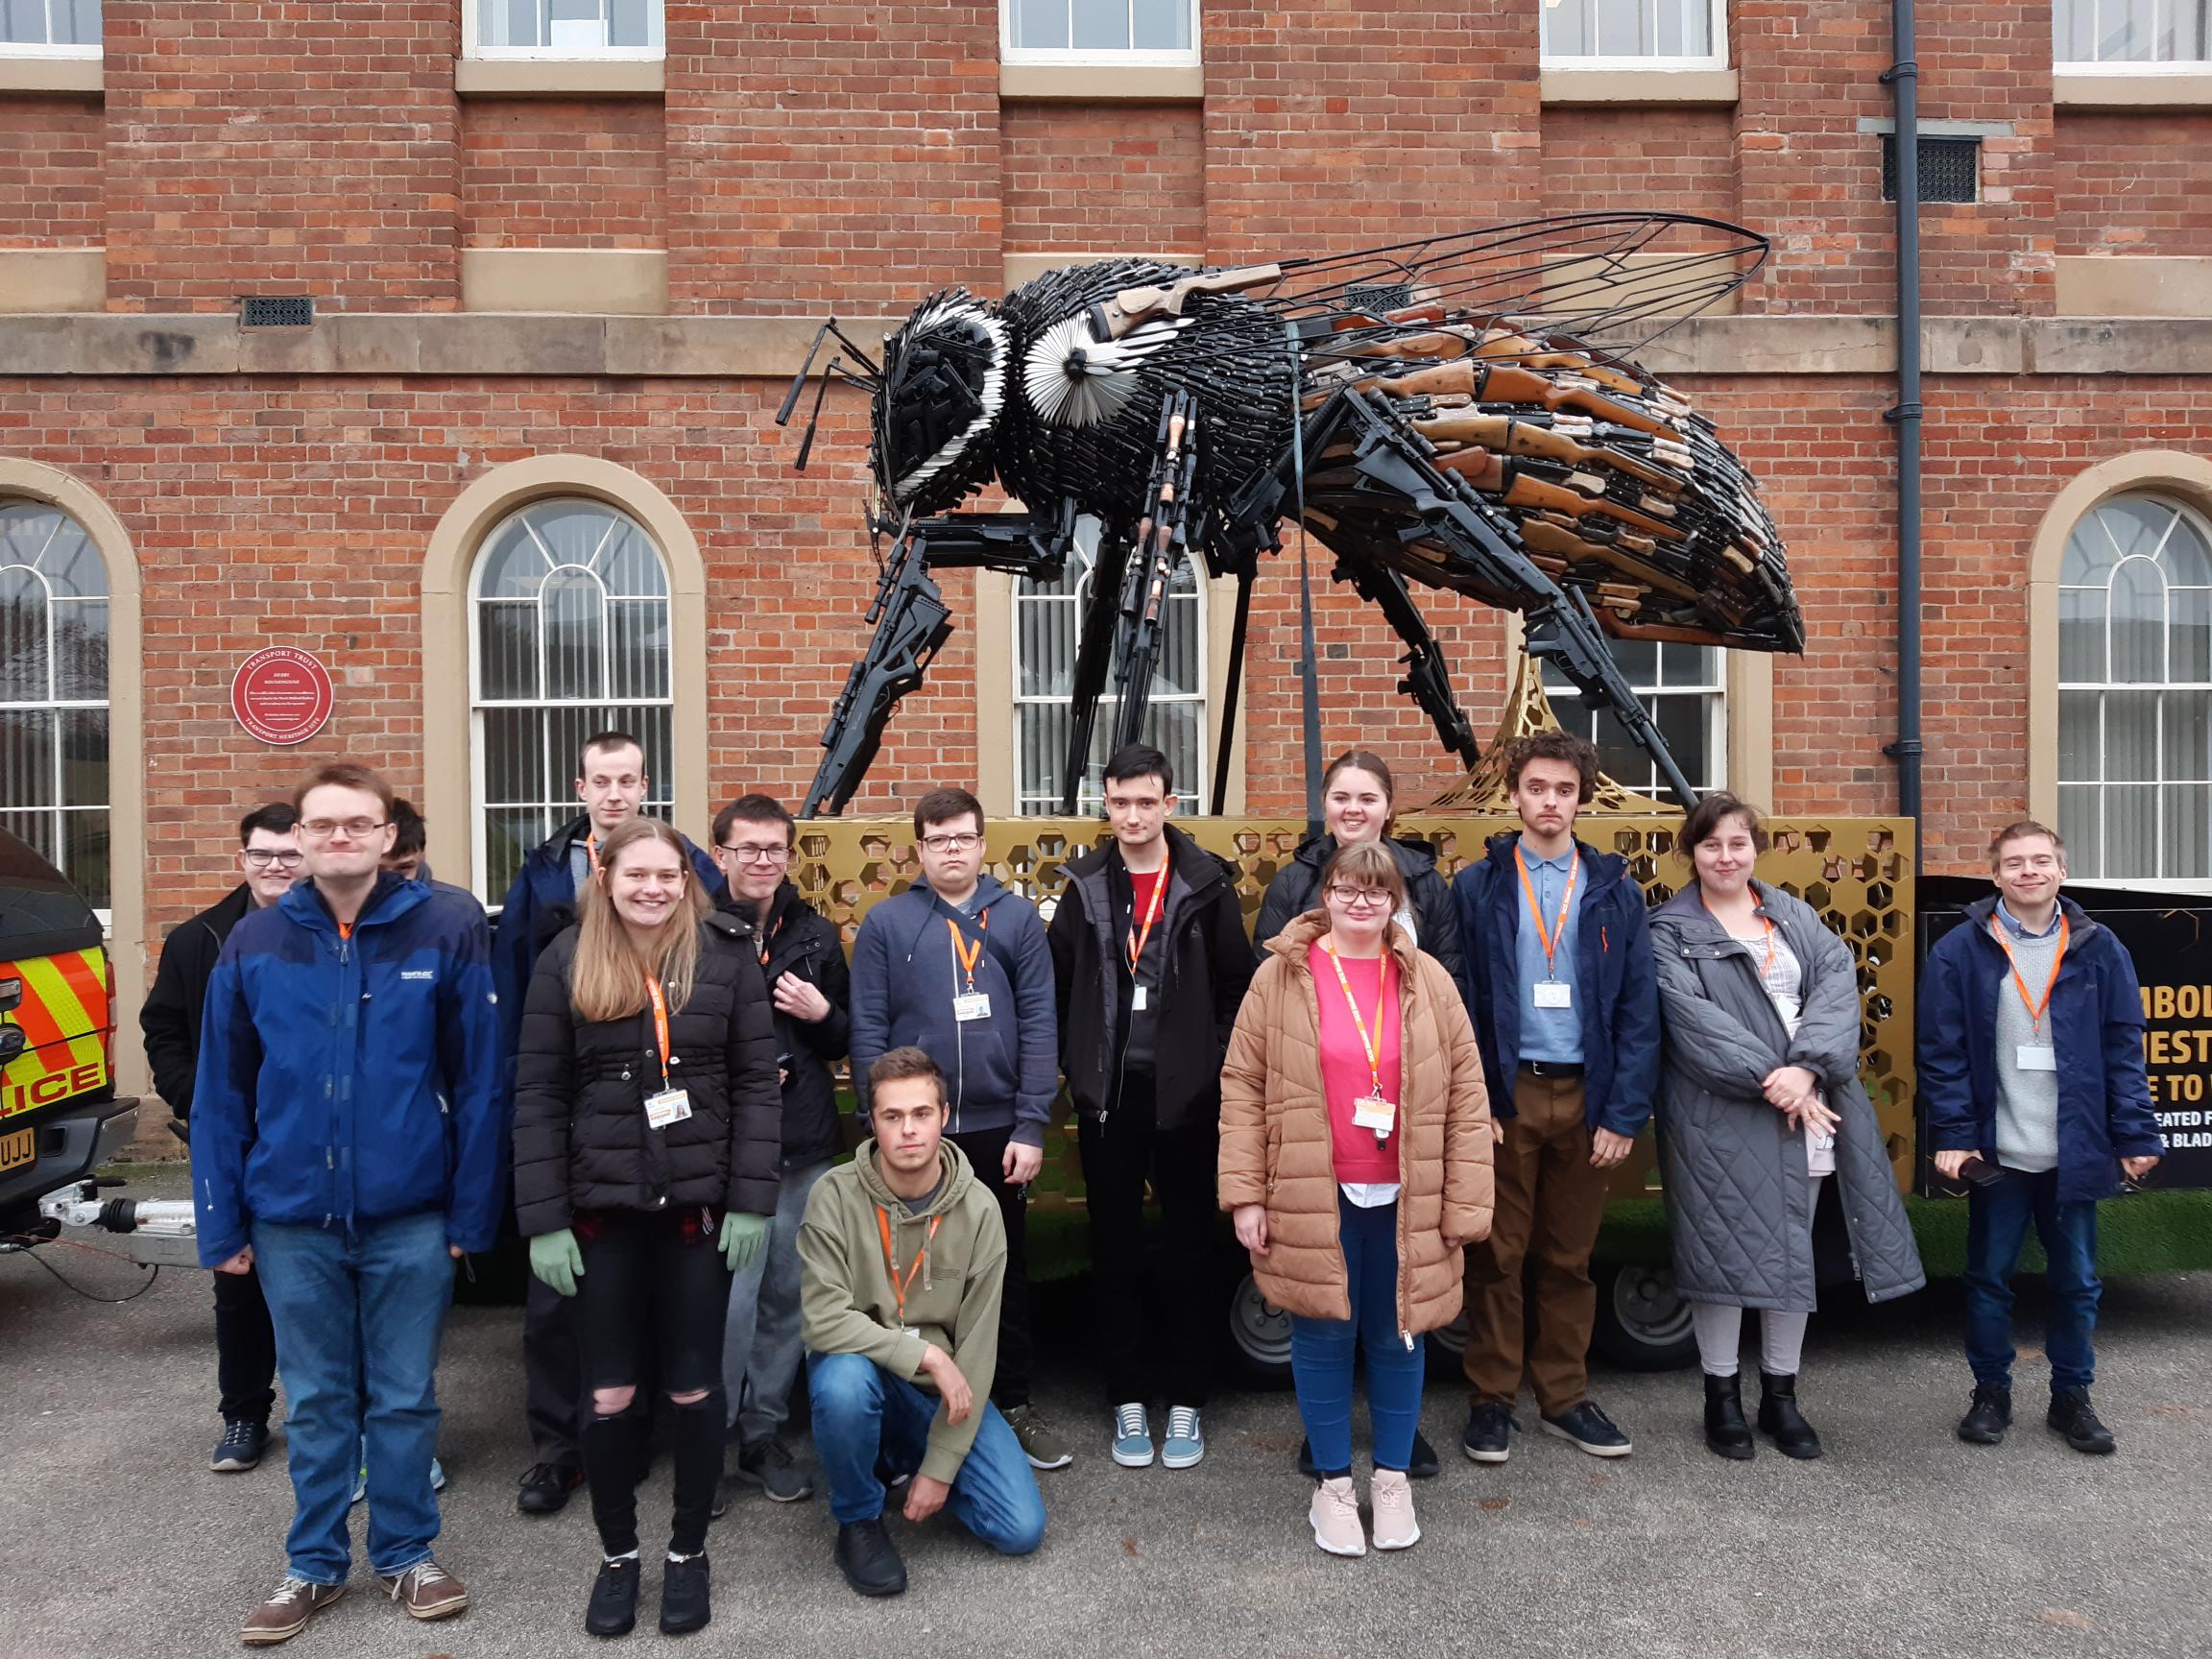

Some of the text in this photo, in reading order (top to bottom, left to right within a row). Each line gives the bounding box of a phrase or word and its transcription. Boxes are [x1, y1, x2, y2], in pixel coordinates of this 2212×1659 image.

[246, 650, 318, 670] TRANSPORT TRUST
[245, 717, 278, 739] TRANSPORT
[278, 727, 310, 740] HERITAGE
[2142, 1030, 2212, 1064] EST
[2166, 1074, 2203, 1101] TO
